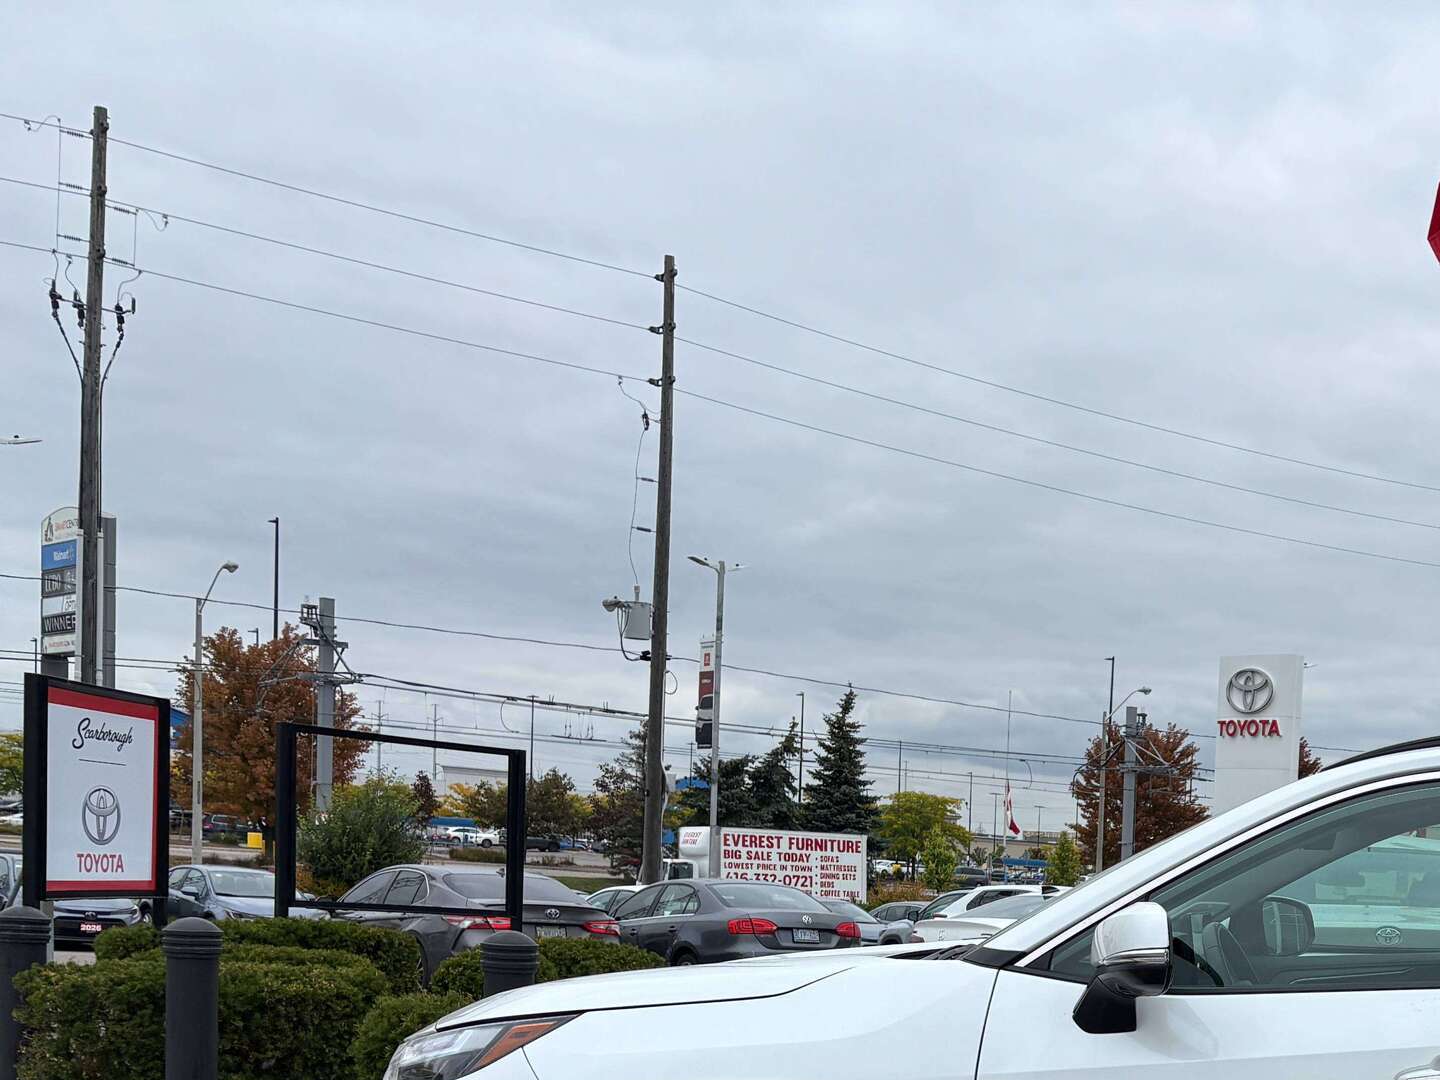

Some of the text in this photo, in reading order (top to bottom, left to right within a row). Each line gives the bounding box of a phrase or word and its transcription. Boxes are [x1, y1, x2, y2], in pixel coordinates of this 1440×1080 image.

[72, 717, 133, 752] Scarborough
[1217, 719, 1281, 737] TOYOTA
[723, 833, 862, 854] EVEREST FURNITURE
[76, 853, 124, 873] TOYOTA
[723, 849, 811, 863] BIG SALE TODAY
[723, 861, 754, 870] LOWEST
[756, 863, 777, 871] PRICE
[790, 865, 813, 873] TOWN
[820, 864, 857, 872] MATTRESSES
[820, 889, 840, 897] COFFEE
